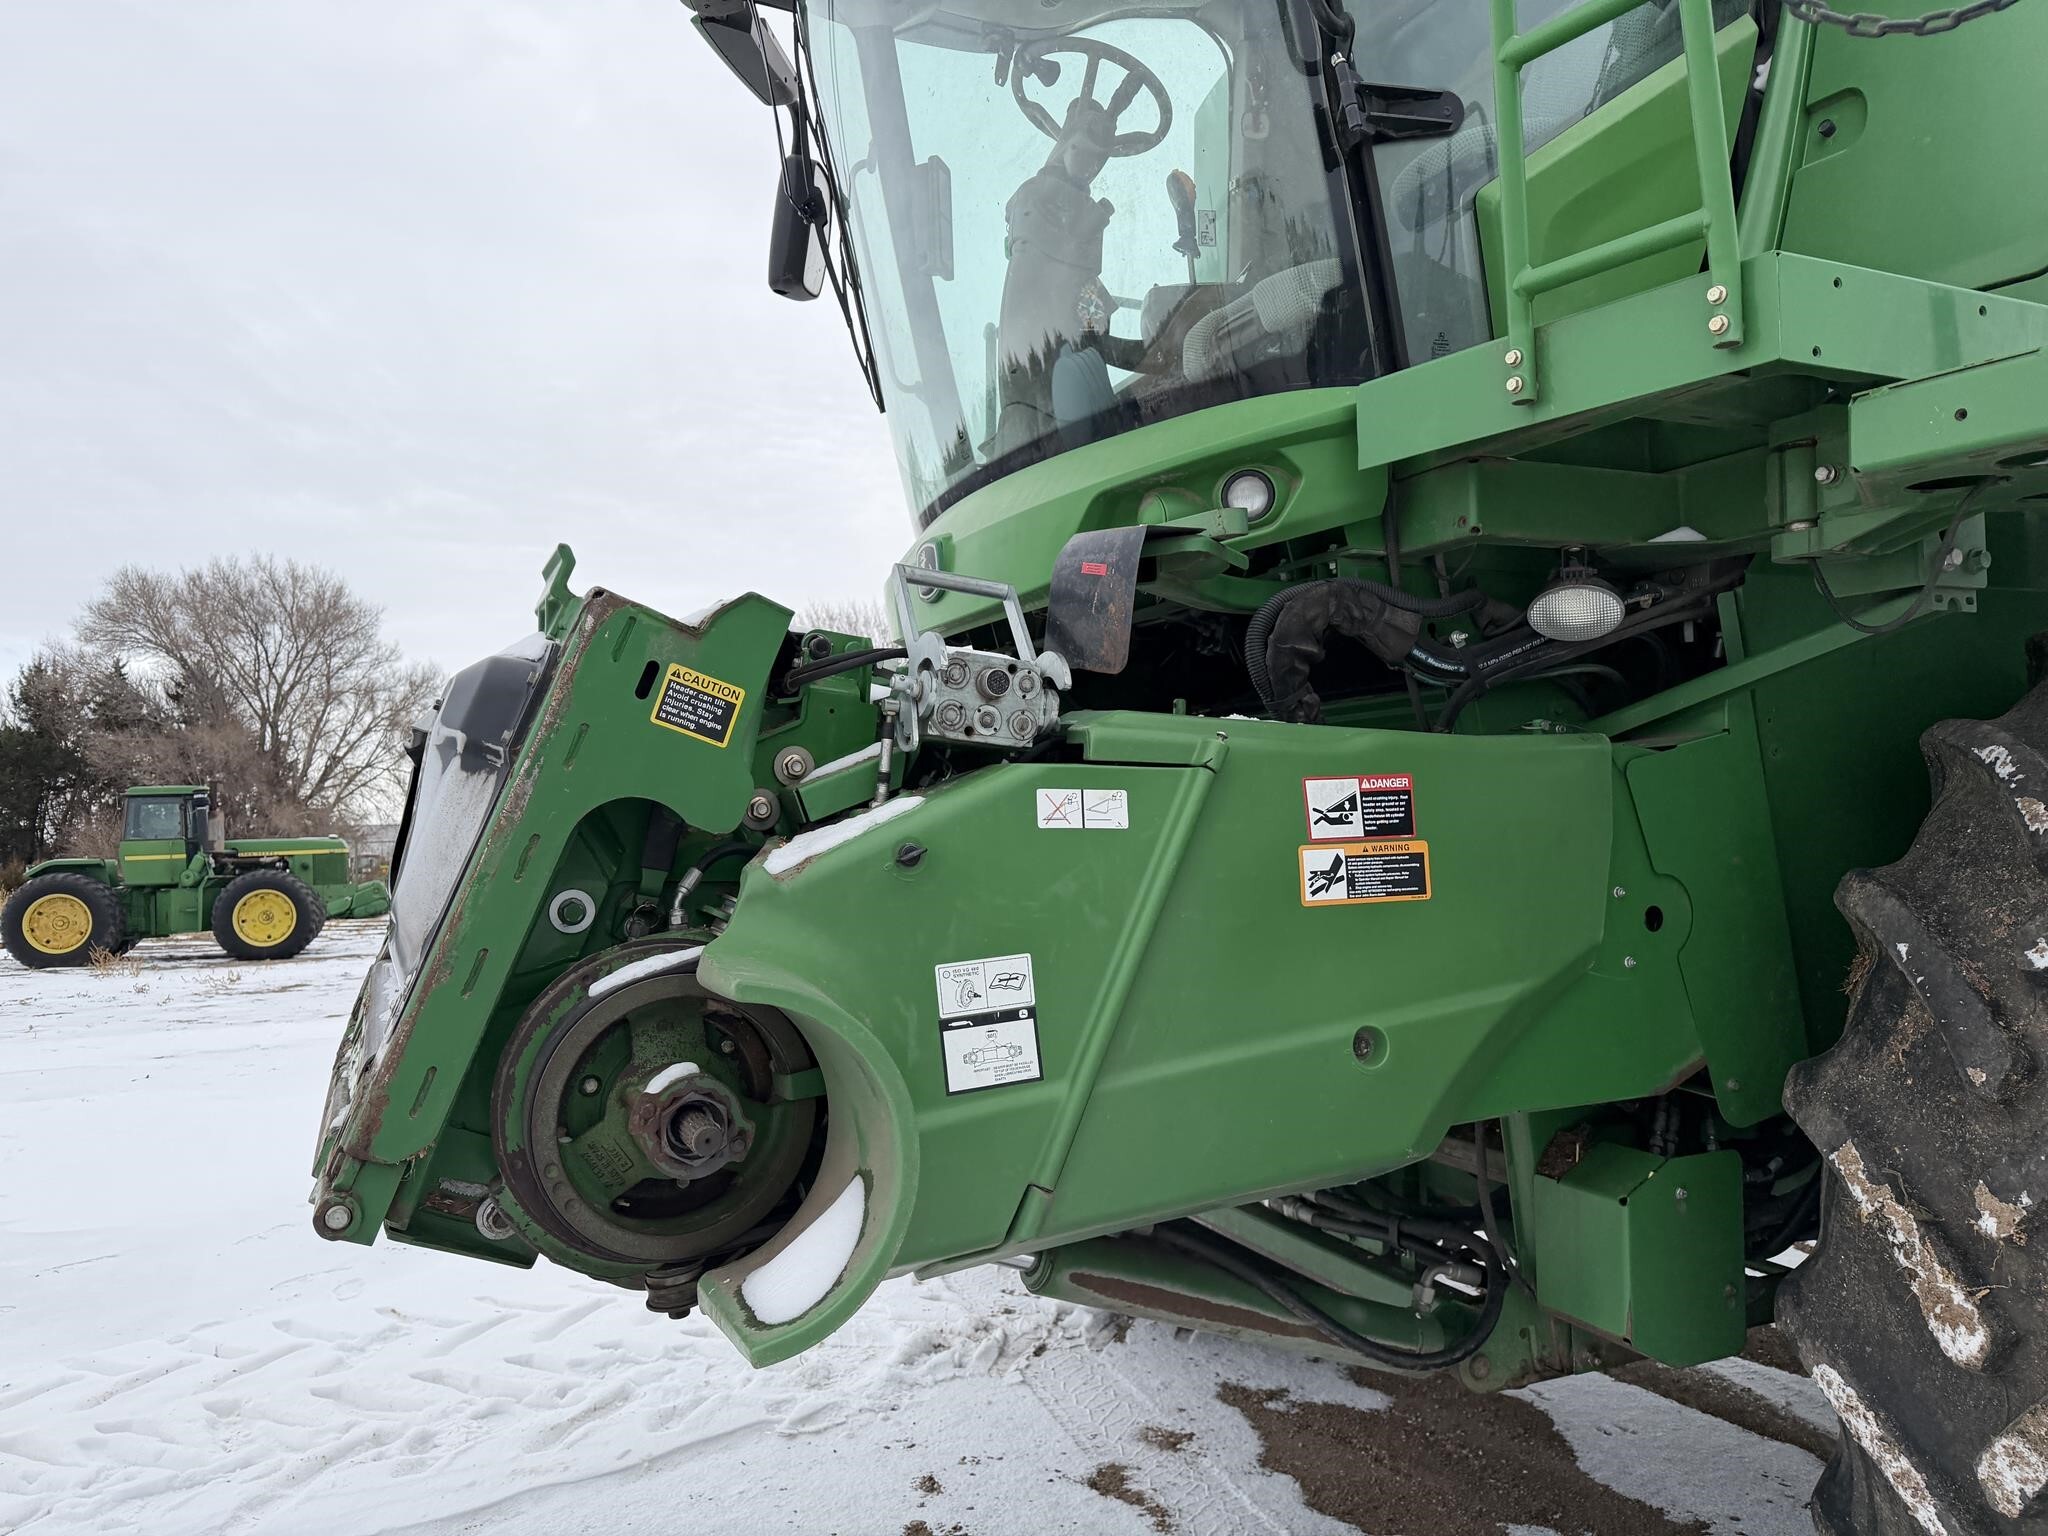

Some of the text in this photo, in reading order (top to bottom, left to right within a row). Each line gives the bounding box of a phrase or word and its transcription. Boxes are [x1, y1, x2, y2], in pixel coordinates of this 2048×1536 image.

[682, 671, 741, 701] CAUTION
[667, 689, 723, 716] Avoid crushing
[670, 681, 727, 708] Header can tilt.
[661, 705, 722, 731] clear when engine
[667, 714, 697, 730] running.
[696, 708, 714, 720] Stay
[1370, 778, 1409, 788] DANGER
[1371, 843, 1410, 853] WARNING
[952, 970, 980, 979] SYNTHETIC
